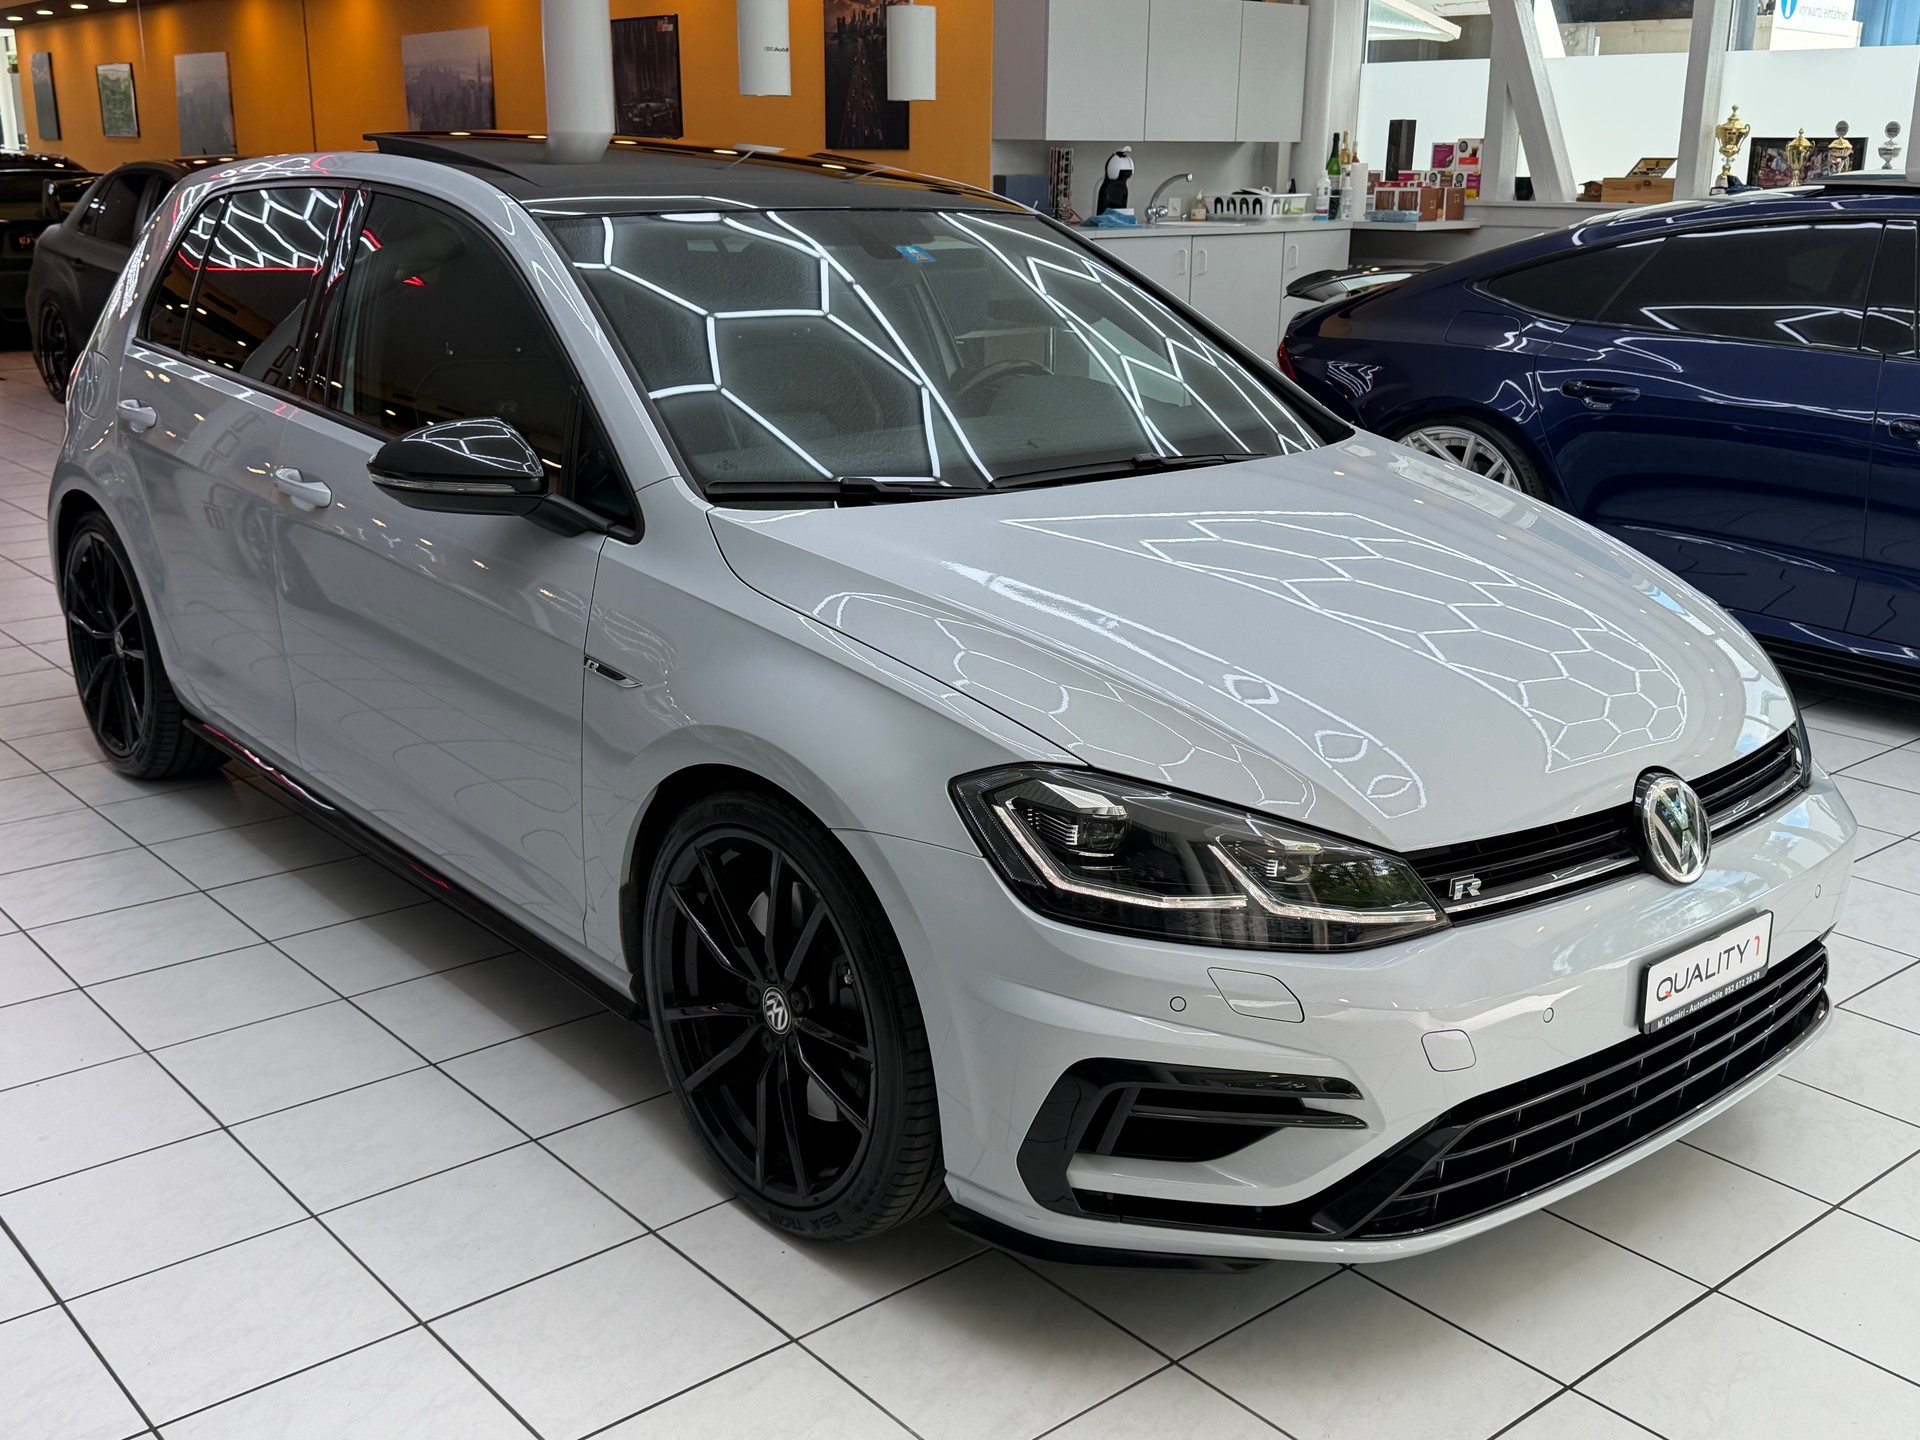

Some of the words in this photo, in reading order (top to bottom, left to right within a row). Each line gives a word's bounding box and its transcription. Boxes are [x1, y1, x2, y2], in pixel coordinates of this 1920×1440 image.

[1450, 874, 1482, 900] R
[1656, 938, 1751, 1002] QUALITY
[1754, 935, 1761, 956] 1
[1665, 1008, 1686, 1025] Demiri
[1689, 991, 1723, 1014] Automobile
